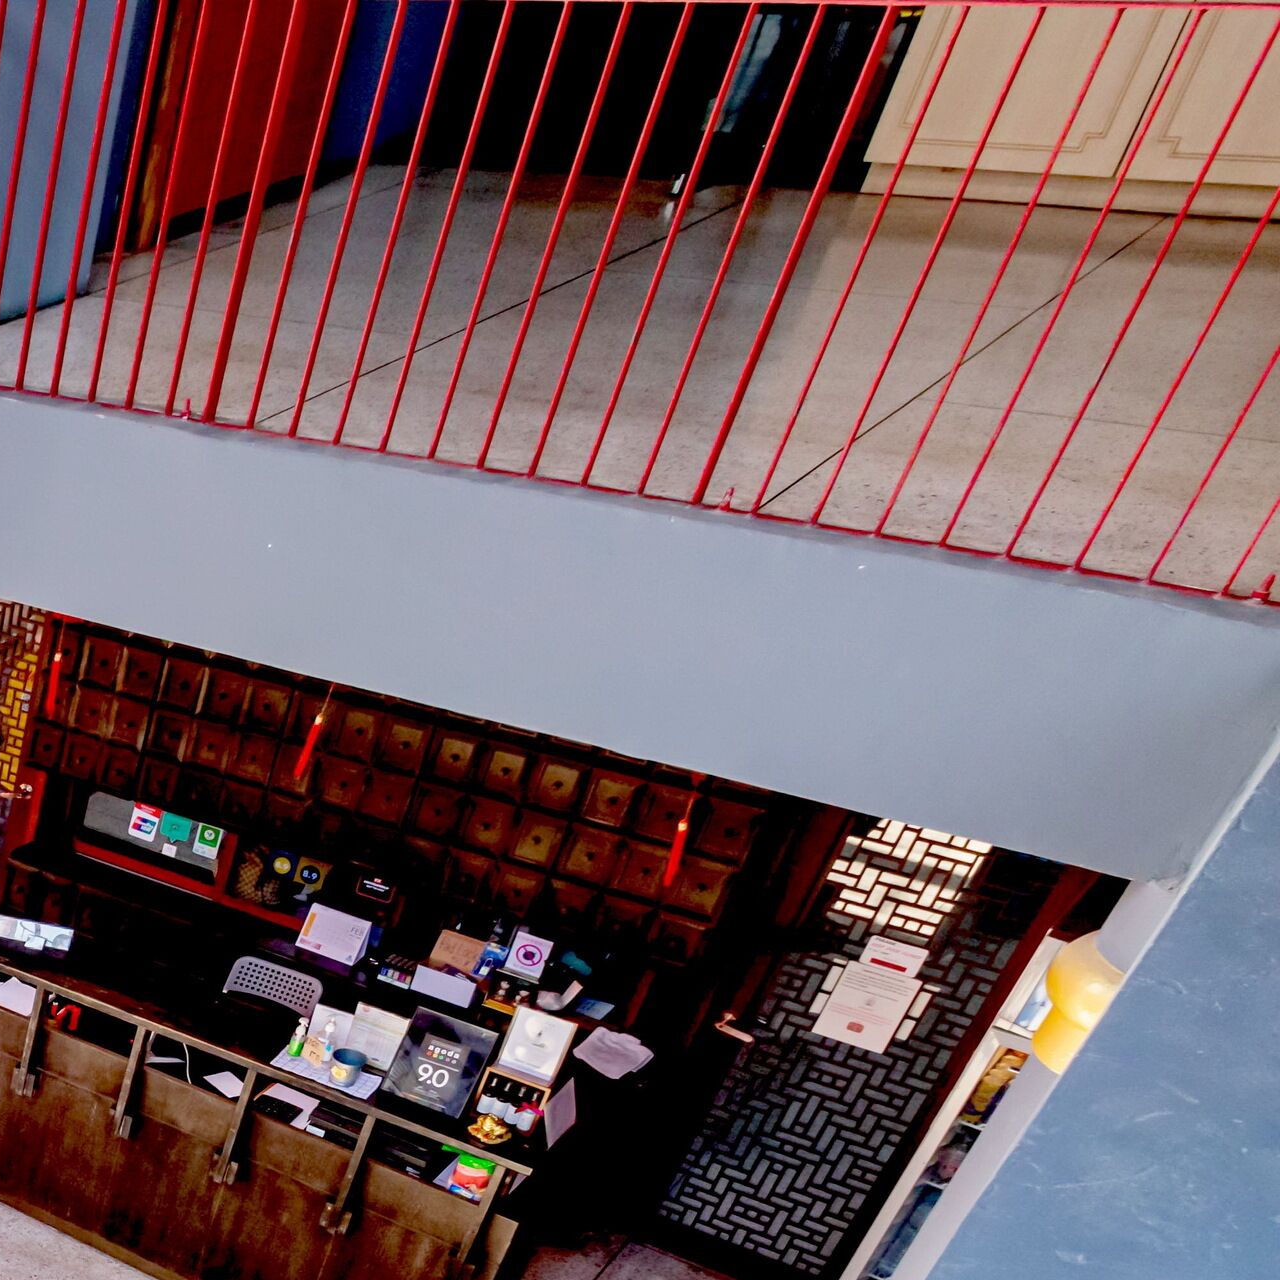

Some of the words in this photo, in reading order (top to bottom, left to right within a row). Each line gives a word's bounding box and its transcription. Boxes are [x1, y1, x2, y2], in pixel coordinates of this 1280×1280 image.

[302, 869, 318, 880] 8.9
[427, 1044, 460, 1059] agoda
[418, 1063, 450, 1088] 9.0
